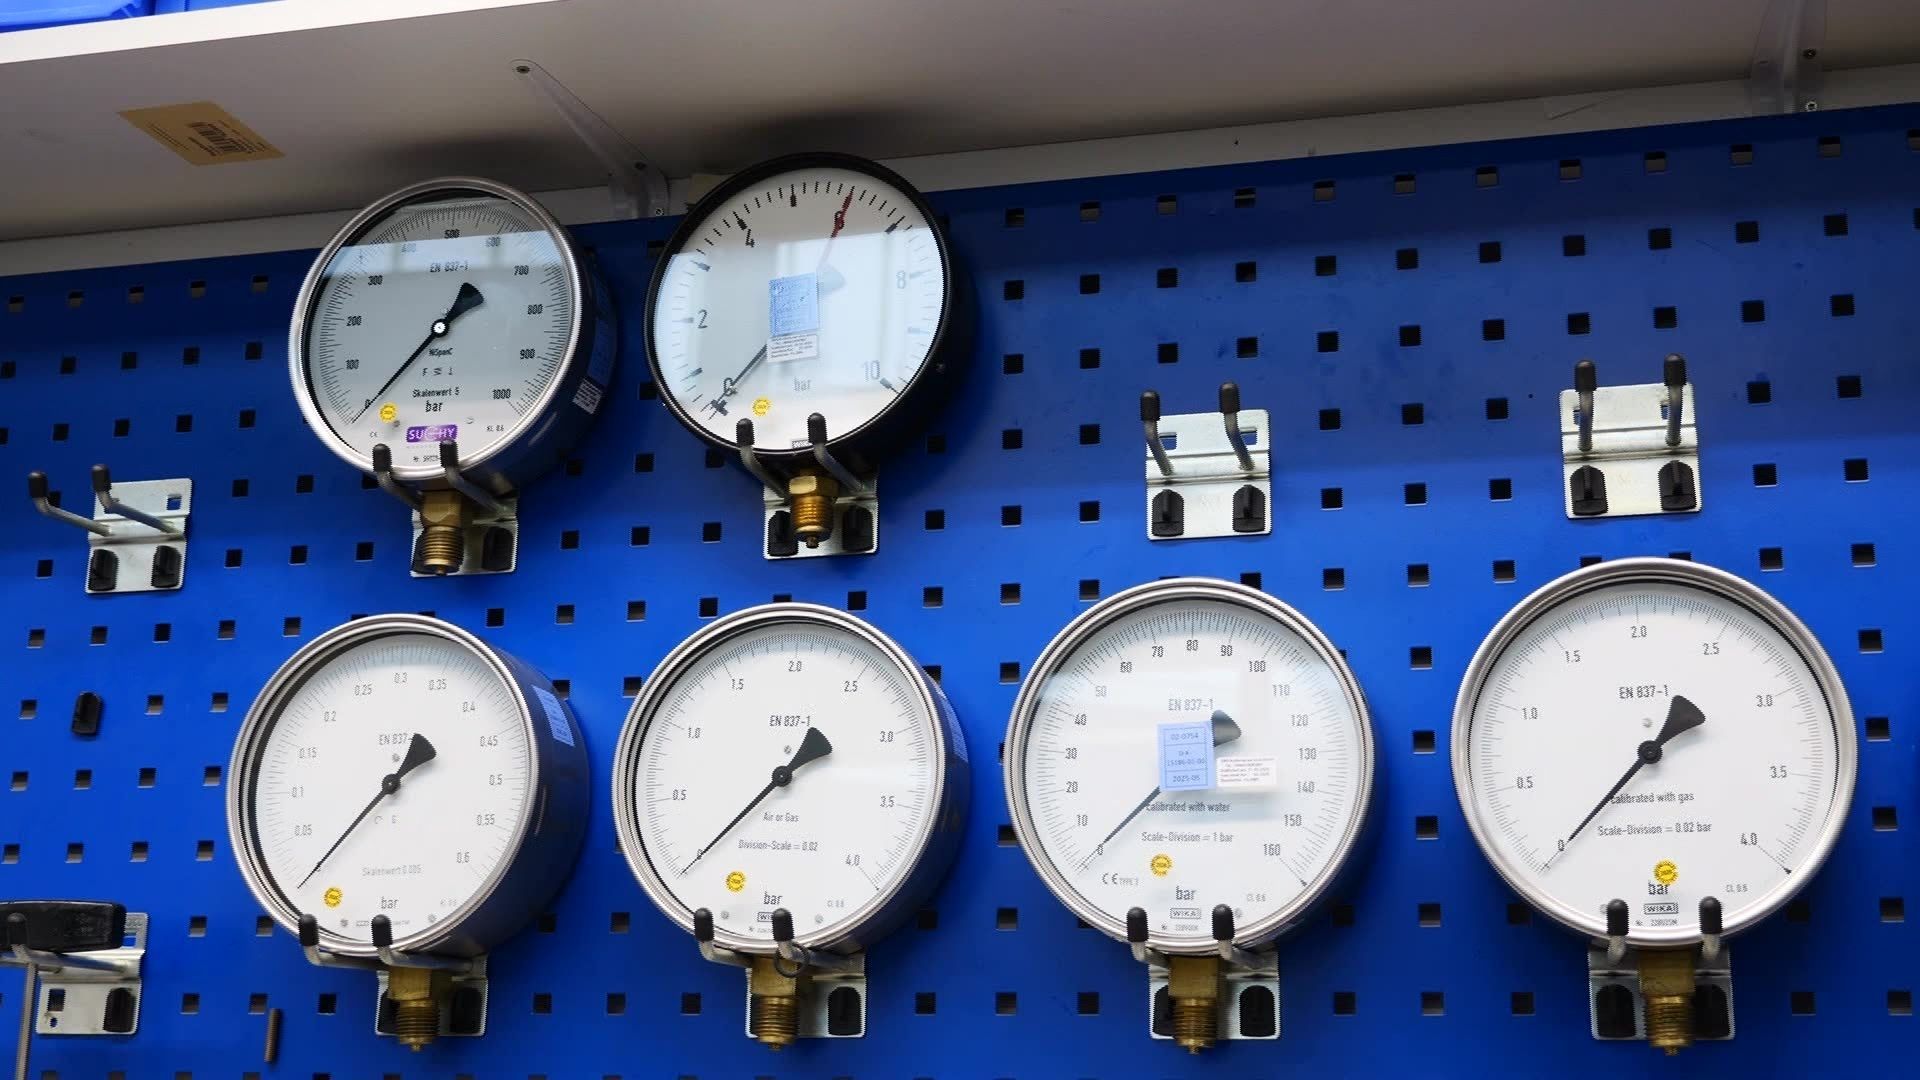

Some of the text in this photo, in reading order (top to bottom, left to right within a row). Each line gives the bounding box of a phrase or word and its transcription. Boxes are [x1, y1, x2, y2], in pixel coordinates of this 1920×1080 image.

[444, 229, 461, 240] 500
[745, 228, 755, 248] 4
[429, 261, 468, 273] EN 837-1
[514, 265, 530, 276] 700
[368, 275, 384, 286] 300
[896, 270, 907, 290] 8
[527, 304, 543, 315] 800
[346, 316, 362, 326] 200
[697, 310, 709, 329] 2
[520, 348, 536, 360] 900
[346, 359, 360, 370] 100
[861, 360, 880, 380] 10
[794, 377, 810, 392] bar
[412, 386, 460, 398] Skalenwert 5
[492, 388, 512, 400] 1000
[426, 400, 443, 412] bar
[1630, 626, 1648, 638] 2.0
[1186, 640, 1199, 651] 80
[1220, 645, 1233, 656] 90
[1703, 643, 1720, 656] 2.5
[1152, 646, 1164, 658] 70
[1564, 650, 1581, 662] 1.5
[788, 661, 802, 672] 2.0
[1120, 662, 1132, 673] 60
[1249, 662, 1266, 673] 100
[731, 679, 744, 691] 1.5
[844, 680, 859, 693] 2.5
[1272, 685, 1290, 696] 110
[1095, 686, 1107, 698] 50
[1618, 684, 1668, 699] EN 837-1
[1168, 698, 1214, 711] EN 837-1
[1756, 695, 1774, 708] 3.0
[1074, 714, 1088, 726] 40
[1521, 708, 1538, 720] 1.0
[770, 714, 810, 727] EN 837-1
[1291, 715, 1309, 726] 120
[688, 727, 702, 740] 1.0
[880, 730, 894, 742] 3.0
[379, 734, 412, 746] EN 837-
[1065, 748, 1077, 760] 30
[1299, 748, 1317, 760] 130
[1770, 766, 1788, 779] 3.5
[1066, 782, 1078, 794] 20
[1296, 782, 1315, 794] 140
[1516, 777, 1534, 790] 0.5
[672, 789, 687, 801] 0.5
[1657, 792, 1676, 802] with
[1678, 793, 1694, 804] gas
[880, 796, 896, 808] 3.5
[1188, 801, 1206, 812] with
[1207, 802, 1231, 812] water
[763, 812, 799, 822] Air or Gas
[1076, 815, 1088, 827] 10
[1284, 815, 1302, 827] 150
[1598, 824, 1662, 836] Scale-Division
[1697, 821, 1712, 832] bar
[1142, 832, 1200, 842] Scale-Division
[1214, 832, 1217, 841] 1
[1220, 832, 1234, 842] bar
[1740, 833, 1758, 846] 4.0
[738, 840, 792, 850] Division-Scale
[1098, 844, 1104, 856] 0
[1263, 844, 1281, 856] 160
[1558, 840, 1565, 852] 0
[697, 848, 704, 860] 0
[846, 854, 860, 867] 4.0
[1176, 886, 1197, 900] bar
[1648, 880, 1669, 895] bar
[380, 896, 398, 910] bar
[764, 891, 783, 905] bar
